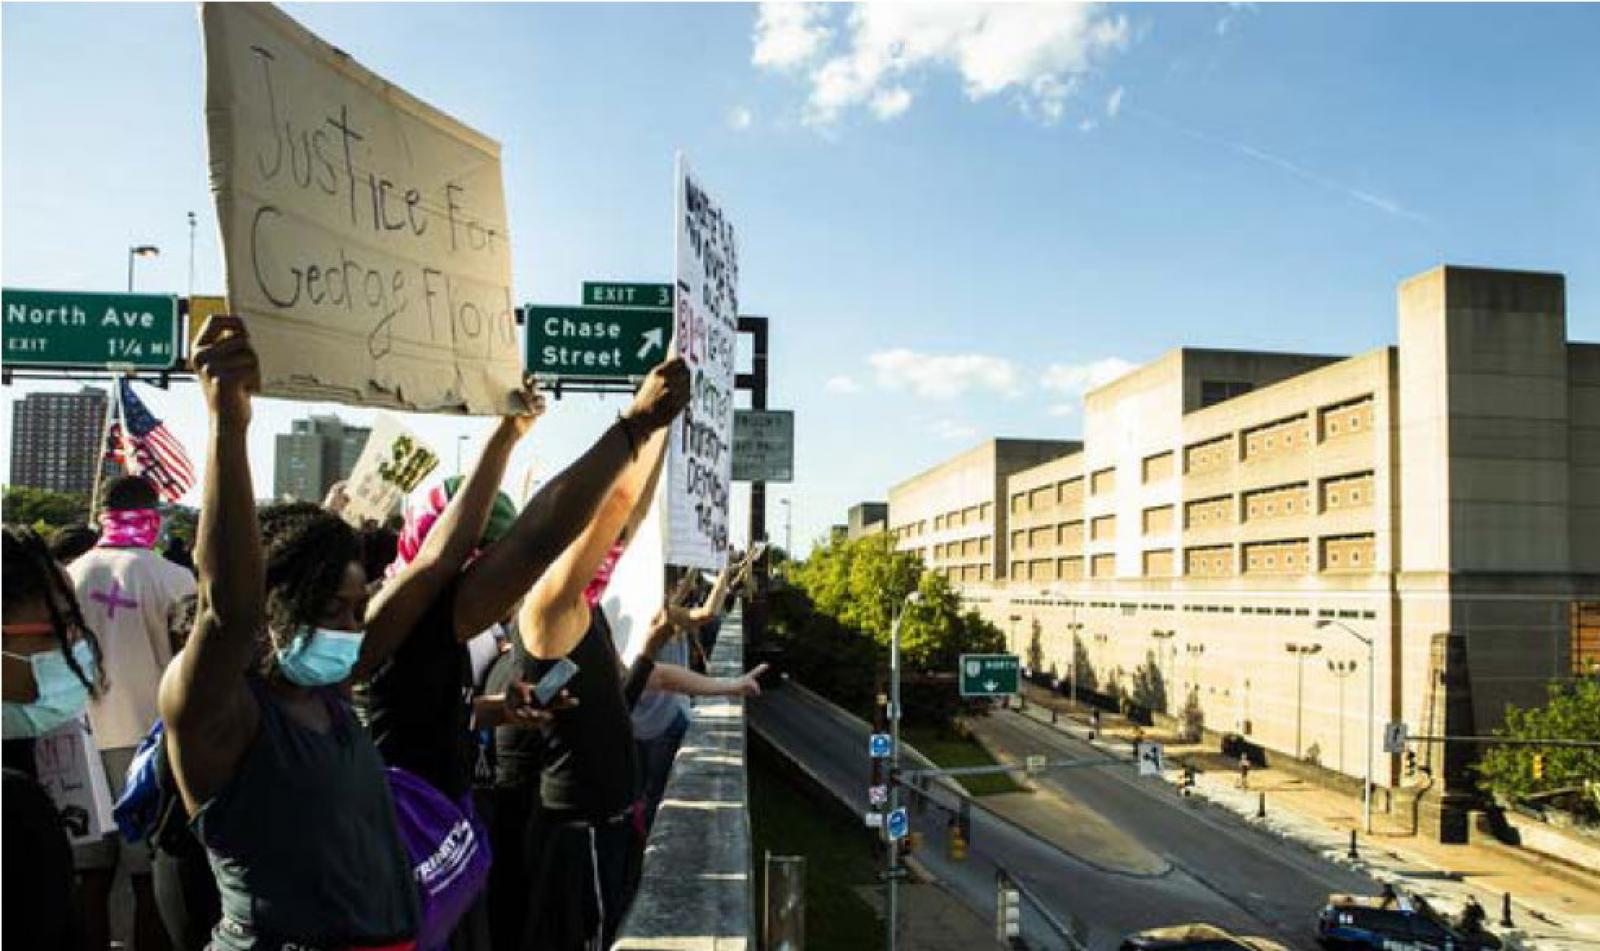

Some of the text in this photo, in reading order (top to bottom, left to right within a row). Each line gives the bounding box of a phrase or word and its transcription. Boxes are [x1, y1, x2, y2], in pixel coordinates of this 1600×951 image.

[250, 44, 497, 253] Justice For
[251, 205, 515, 361] George Floyd
[593, 286, 671, 305] EXIT 3
[7, 303, 155, 328] North Ave
[544, 316, 622, 339] Chase
[8, 337, 48, 353] EXIT
[150, 343, 171, 356] MI
[541, 345, 622, 368] Street
